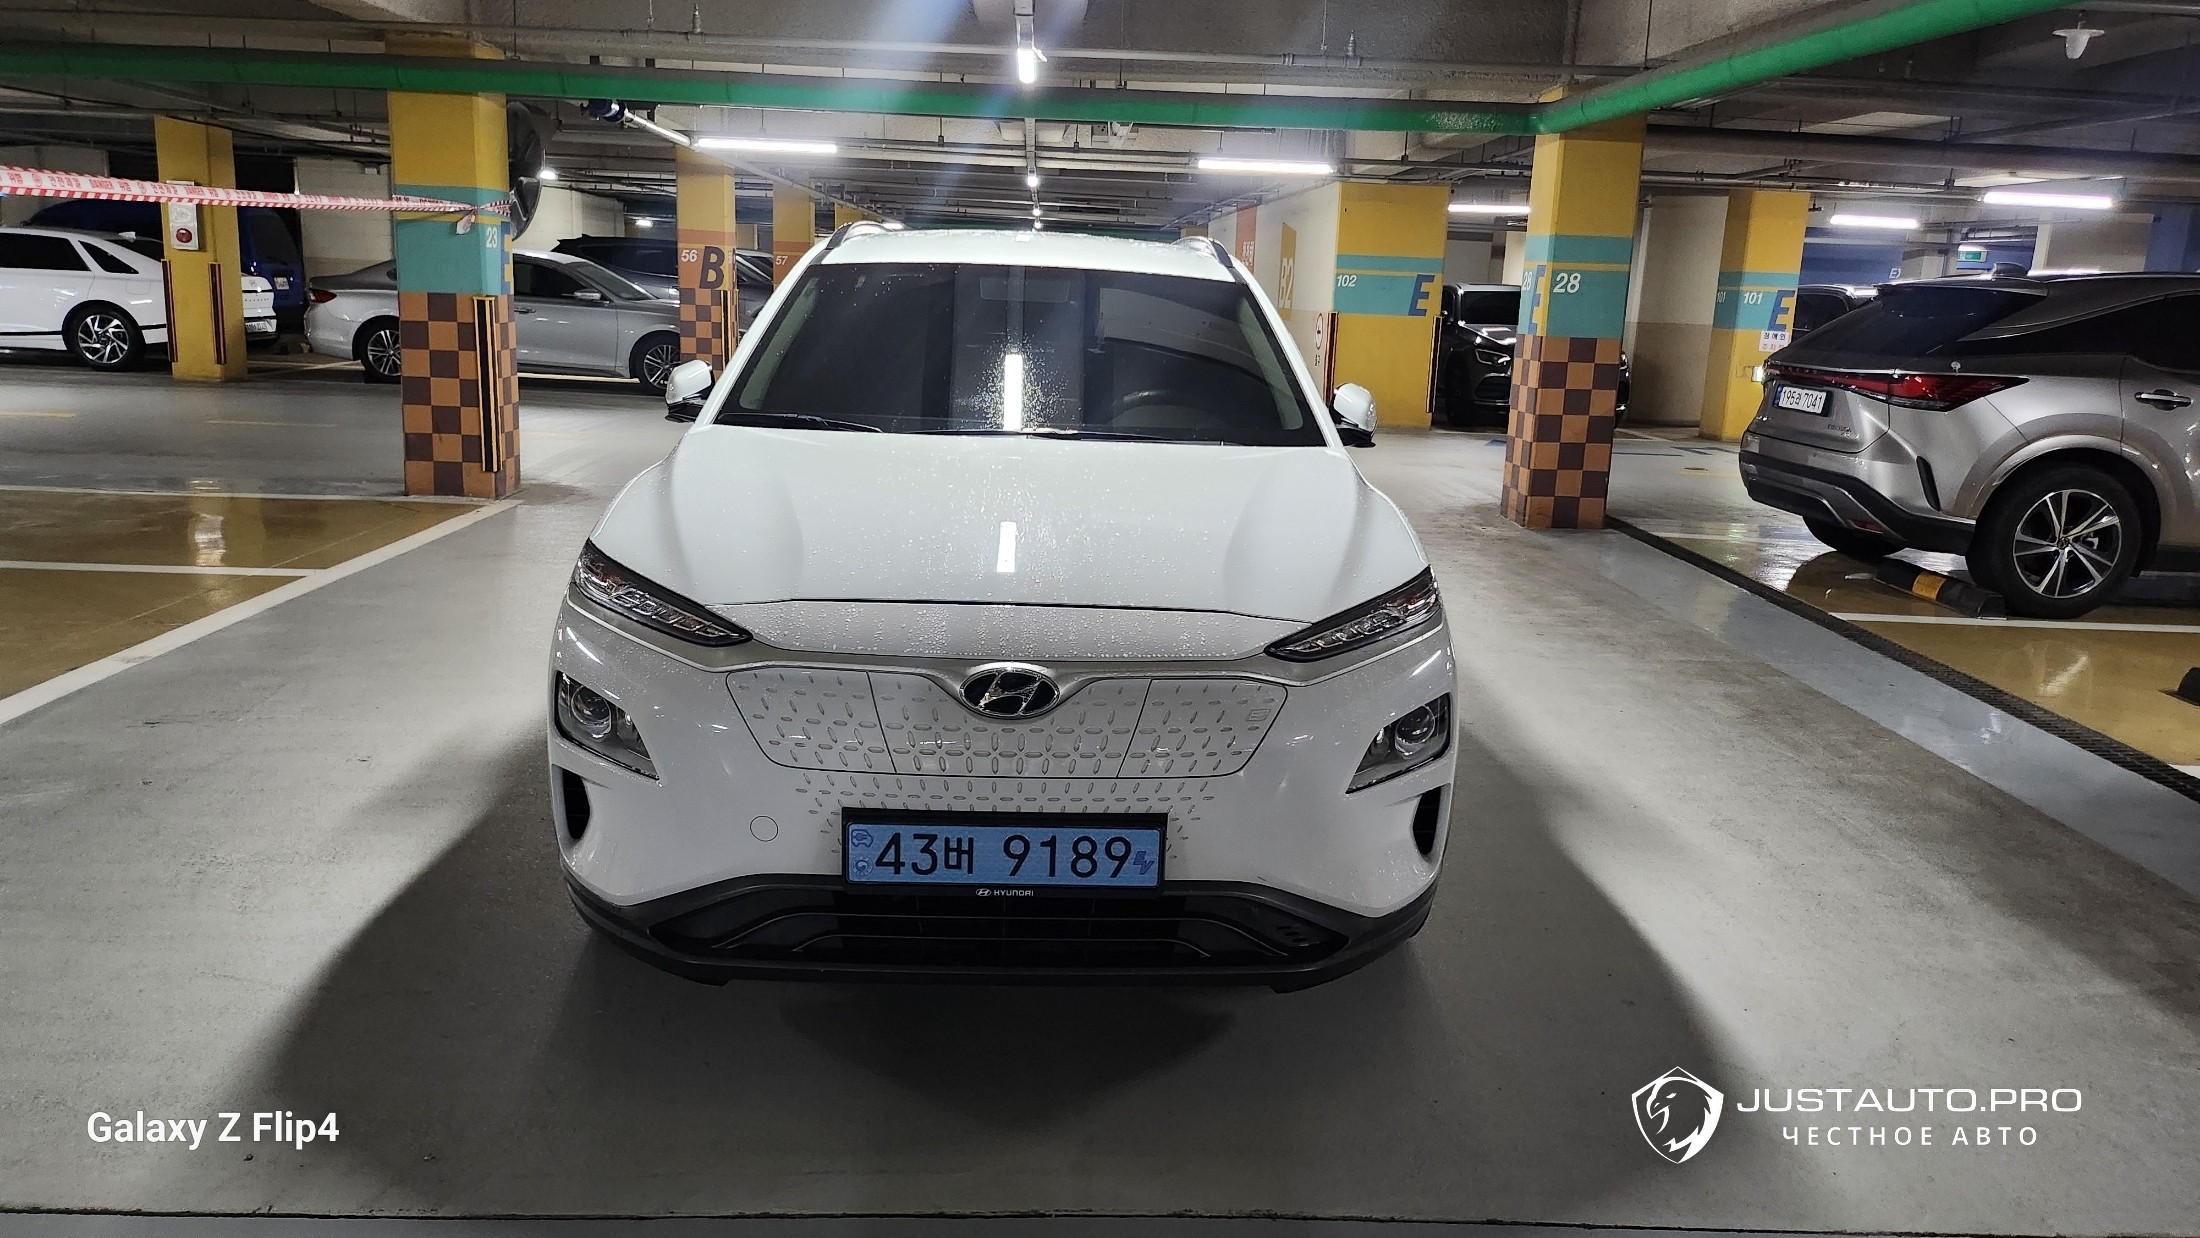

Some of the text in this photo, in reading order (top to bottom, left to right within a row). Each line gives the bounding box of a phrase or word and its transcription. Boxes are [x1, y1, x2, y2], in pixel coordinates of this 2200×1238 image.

[485, 226, 498, 249] 23
[681, 249, 698, 263] 56
[699, 245, 726, 289] B
[775, 255, 788, 266] 57
[1336, 274, 1357, 288] 102
[1522, 271, 1533, 292] 28
[1552, 272, 1581, 294] 28
[1408, 273, 1436, 317] E
[1528, 264, 1546, 335] E
[1743, 291, 1763, 305] 101
[1766, 289, 1796, 332] E
[1802, 392, 1823, 411] 7041
[875, 832, 1132, 879] 43버 9189
[1133, 850, 1155, 876] EV
[993, 889, 1034, 897] HYUNDAI
